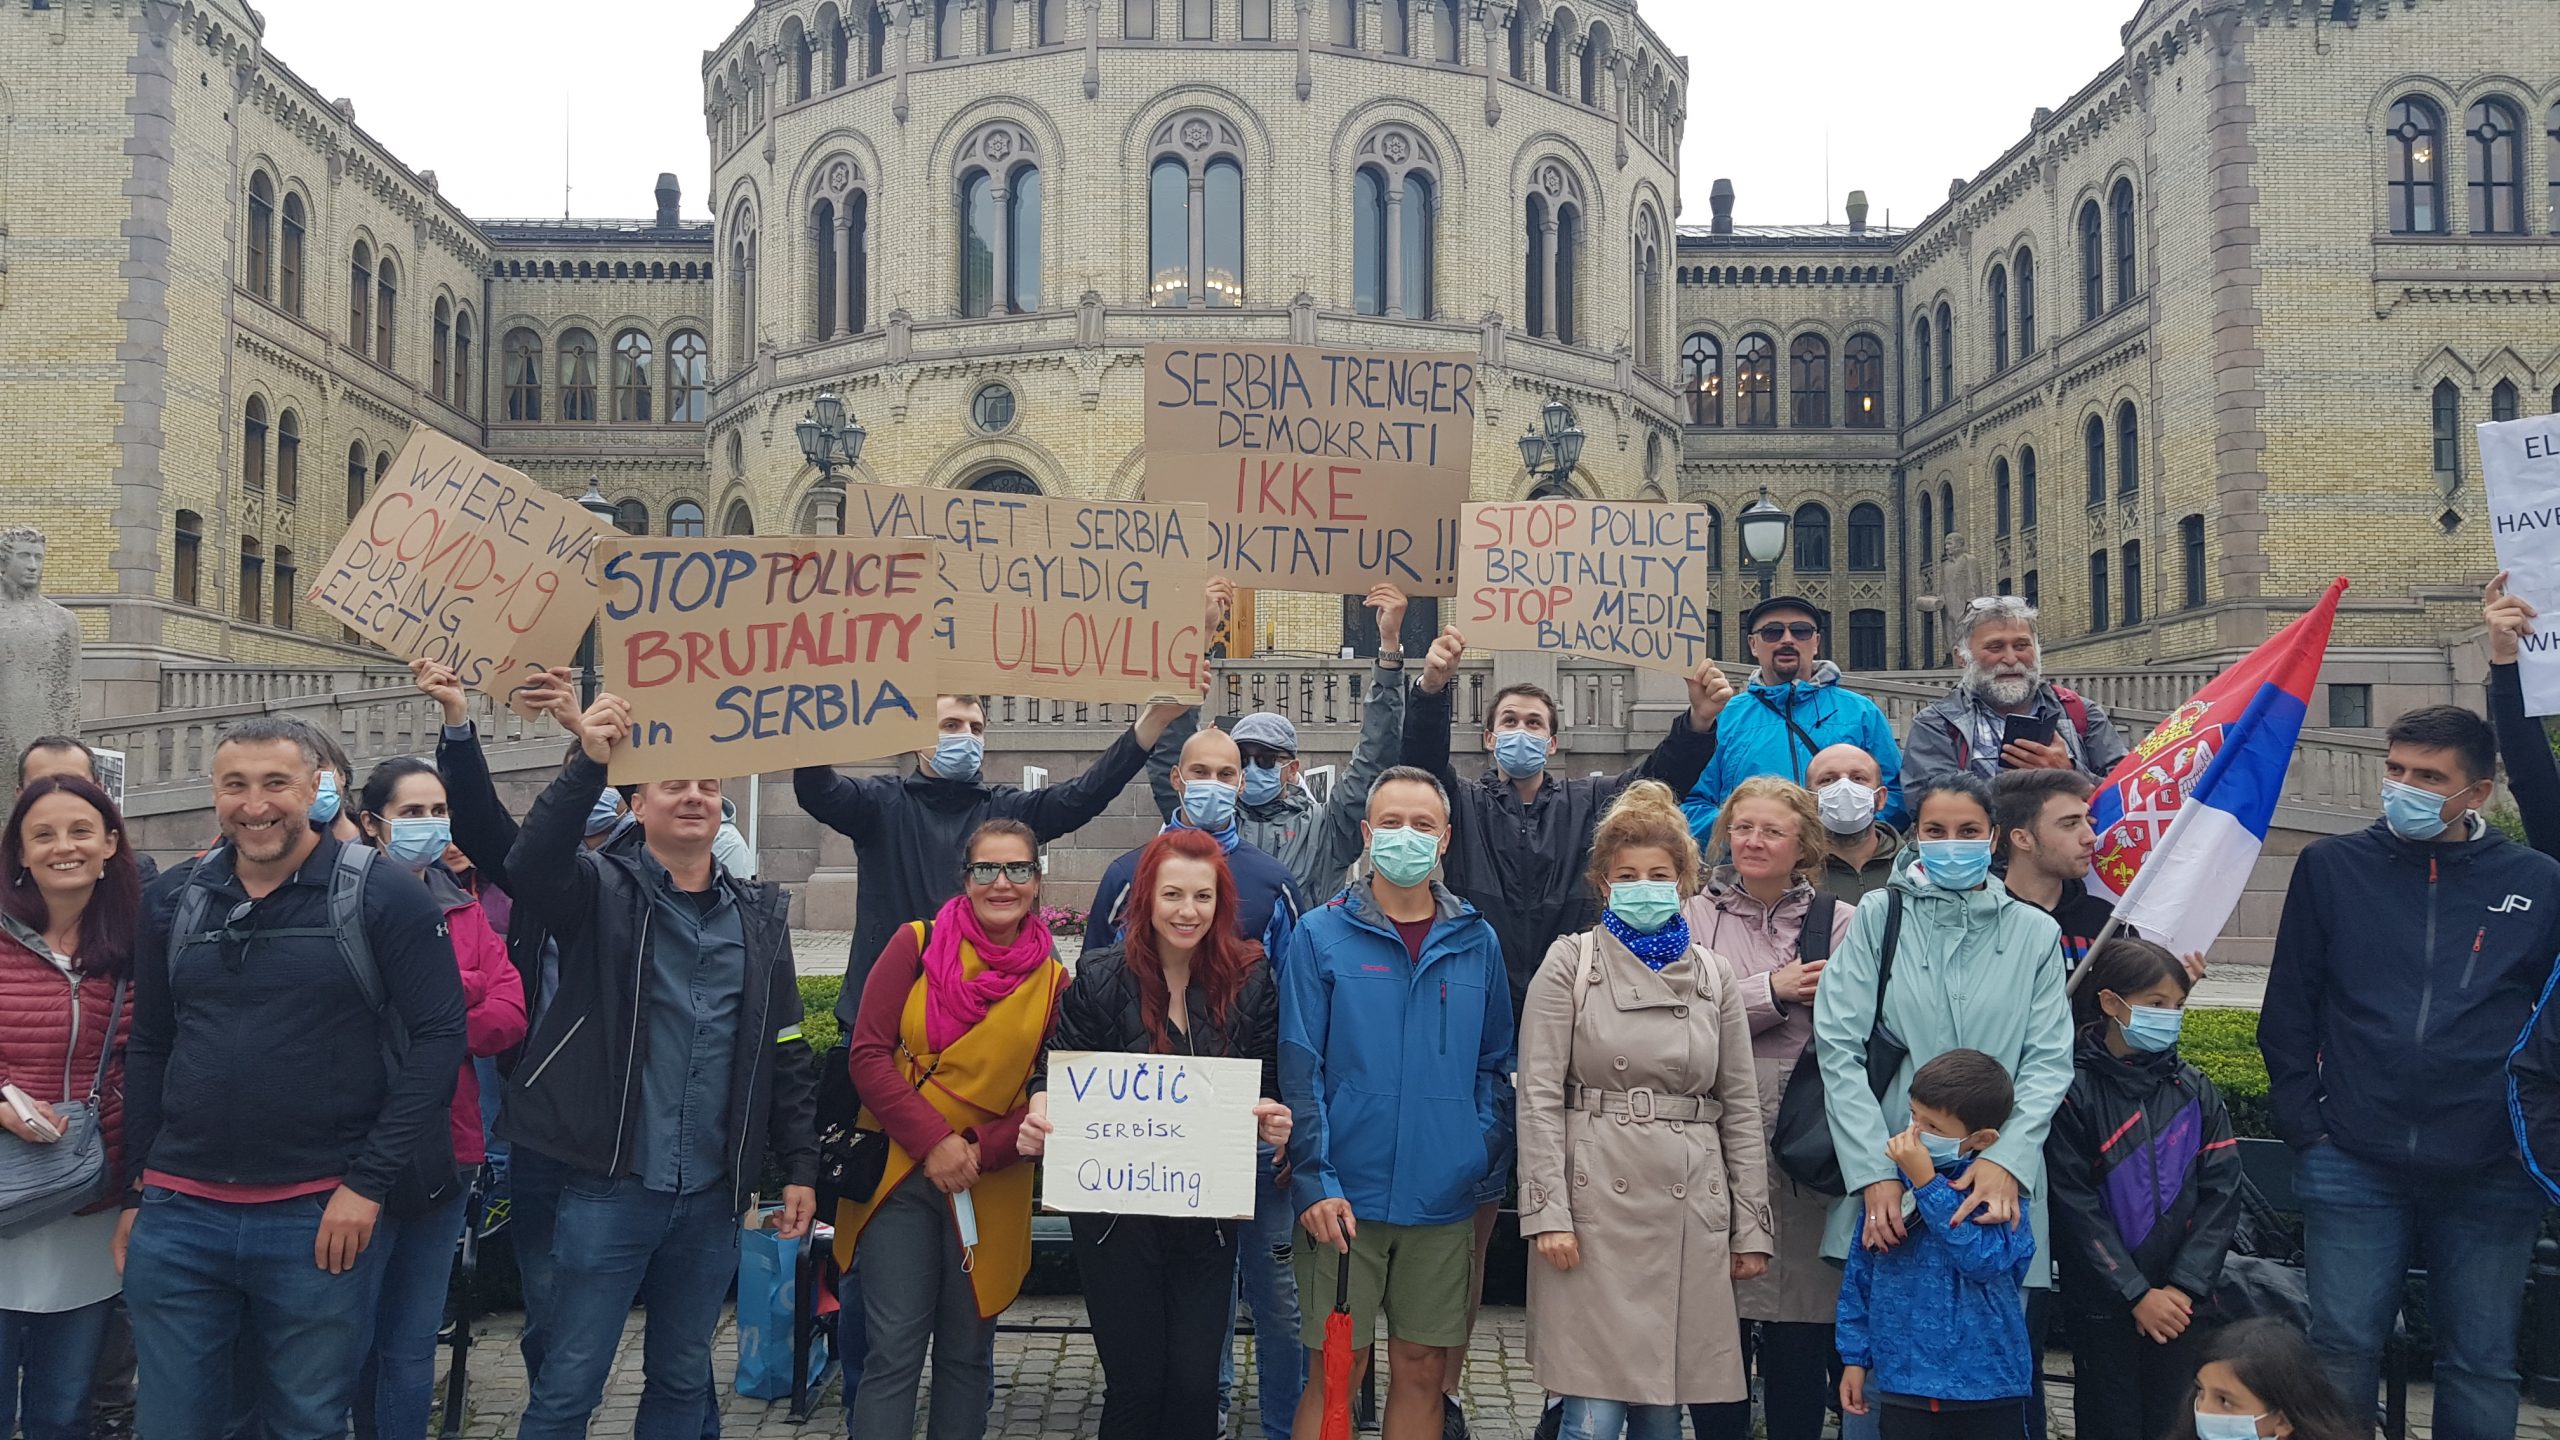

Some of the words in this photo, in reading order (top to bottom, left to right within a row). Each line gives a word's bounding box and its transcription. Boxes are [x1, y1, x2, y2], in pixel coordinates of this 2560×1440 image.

[1158, 350, 1312, 410] SERBIA
[1321, 355, 1475, 418] TRENGER
[1218, 410, 1438, 466] DEMOKRATI
[409, 444, 546, 546] WHERE
[546, 515, 598, 587] WA
[1237, 457, 1368, 521] IKKE
[863, 489, 1028, 551] VALGET
[1045, 503, 1052, 549] I
[1070, 507, 1190, 559] SERBIA
[1473, 503, 1577, 550] STOP
[1590, 505, 1706, 551] POLICE
[345, 538, 475, 637] DURING
[370, 491, 560, 634] COVID-19
[603, 549, 758, 620] STOP
[761, 548, 927, 605] POLICE
[979, 551, 1149, 610] UGYLDIG
[1486, 548, 1688, 597] BRUTALITY
[1471, 585, 1573, 626] STOP
[1592, 590, 1705, 632] MEDIA
[624, 607, 924, 688] BRUTALITY
[992, 602, 1200, 689] ULOVLIG
[1537, 619, 1706, 667] BLACKOUT
[710, 678, 919, 743] SERBIA
[1077, 1158, 1201, 1208] Quisling
